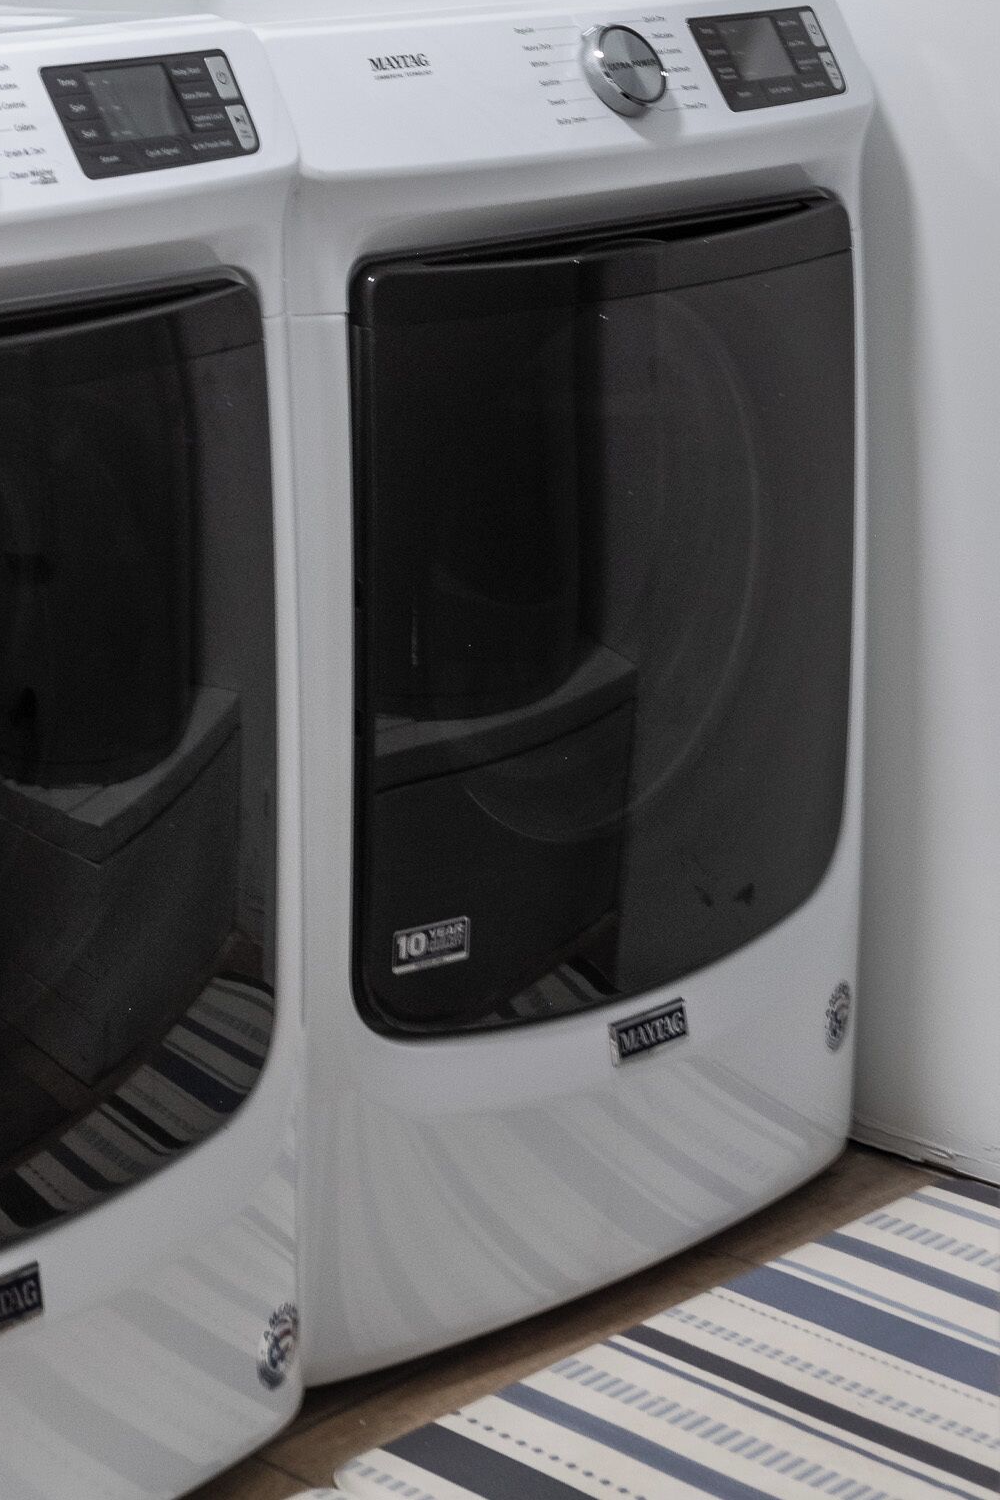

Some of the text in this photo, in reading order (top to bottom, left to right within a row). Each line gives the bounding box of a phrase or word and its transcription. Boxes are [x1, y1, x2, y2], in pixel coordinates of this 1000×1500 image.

[367, 53, 431, 71] MAYTAG
[397, 932, 427, 960] 10
[619, 1010, 685, 1053] MAYTAG
